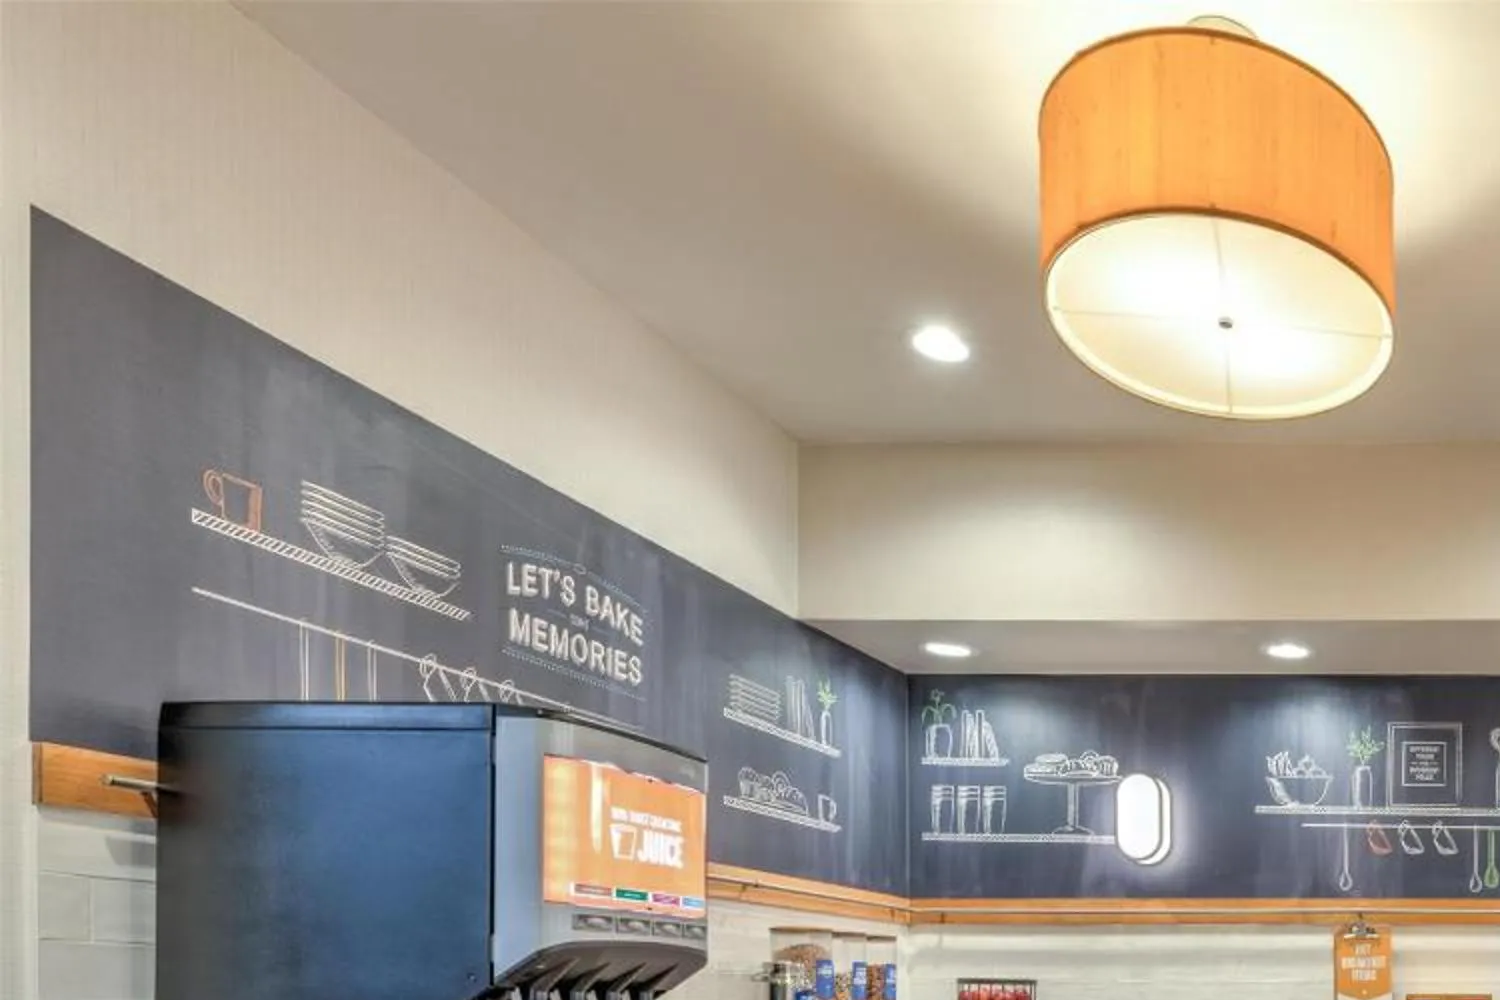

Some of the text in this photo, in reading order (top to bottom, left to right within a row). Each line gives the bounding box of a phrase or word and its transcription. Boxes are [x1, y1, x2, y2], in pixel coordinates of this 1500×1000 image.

[506, 562, 644, 647] LET'S BAKE
[508, 607, 642, 686] MEMORIES
[637, 830, 684, 869] JUICE
